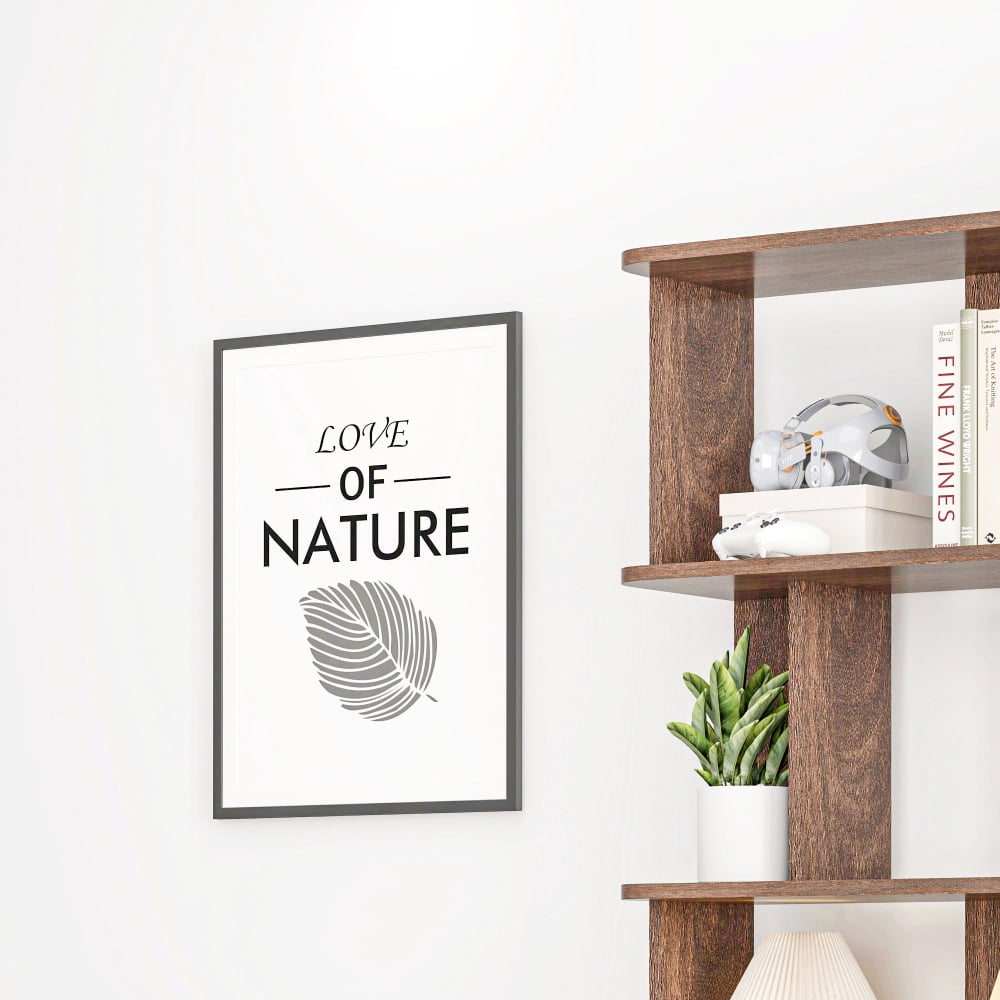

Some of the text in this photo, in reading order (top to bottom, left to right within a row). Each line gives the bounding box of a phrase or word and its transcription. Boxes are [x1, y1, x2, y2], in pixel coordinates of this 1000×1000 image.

[989, 381, 997, 408] Knitting
[315, 417, 409, 454] LOVE
[938, 356, 955, 522] FINE WINES
[962, 385, 971, 473] FRANK LLOYD WRIGHT
[339, 464, 387, 500] OF
[263, 507, 469, 568] NATURE
